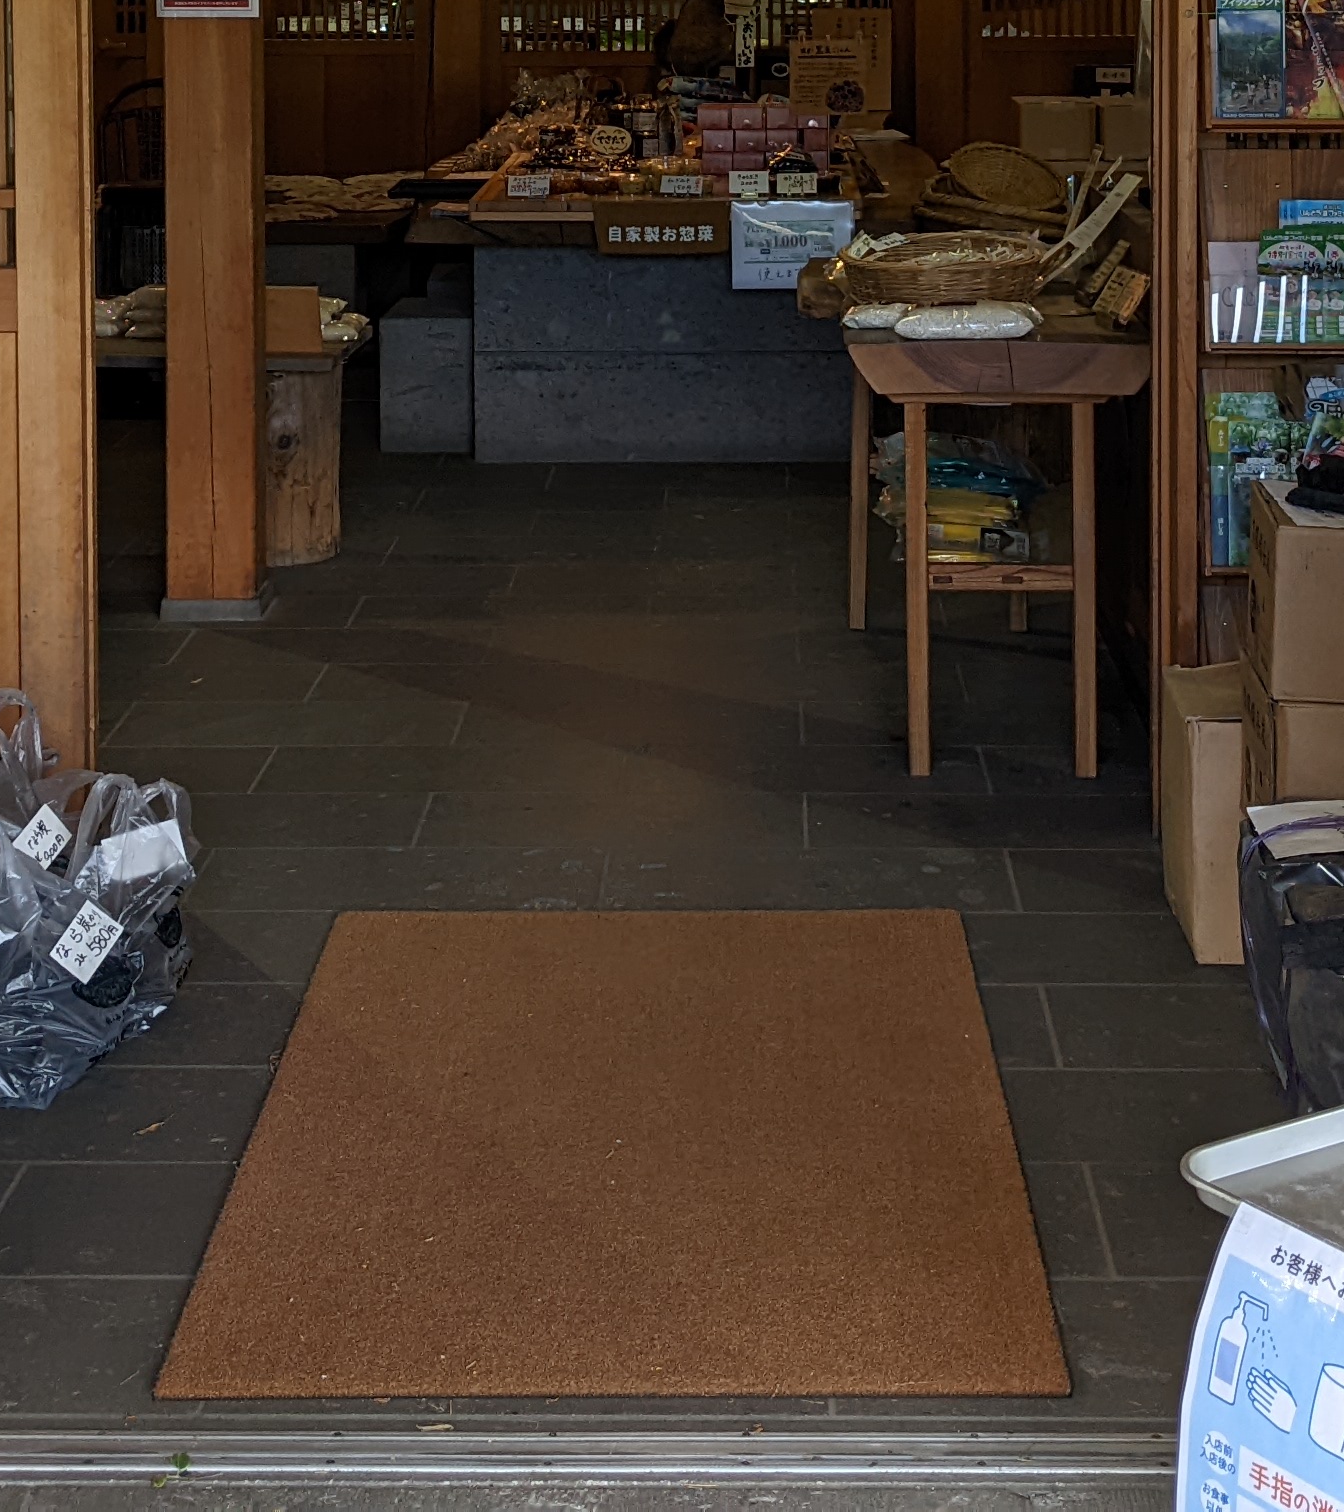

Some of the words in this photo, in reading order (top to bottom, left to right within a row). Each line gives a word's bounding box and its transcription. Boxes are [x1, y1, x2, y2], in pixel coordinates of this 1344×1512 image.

[741, 21, 754, 66] おいしいよ
[608, 225, 715, 243] 自家製お惣菜
[758, 267, 800, 281] 使えま
[86, 923, 120, 957] 580円
[1204, 1433, 1233, 1459] 入店前
[1199, 1446, 1236, 1475] 入店後の
[1202, 1482, 1230, 1506] お食事
